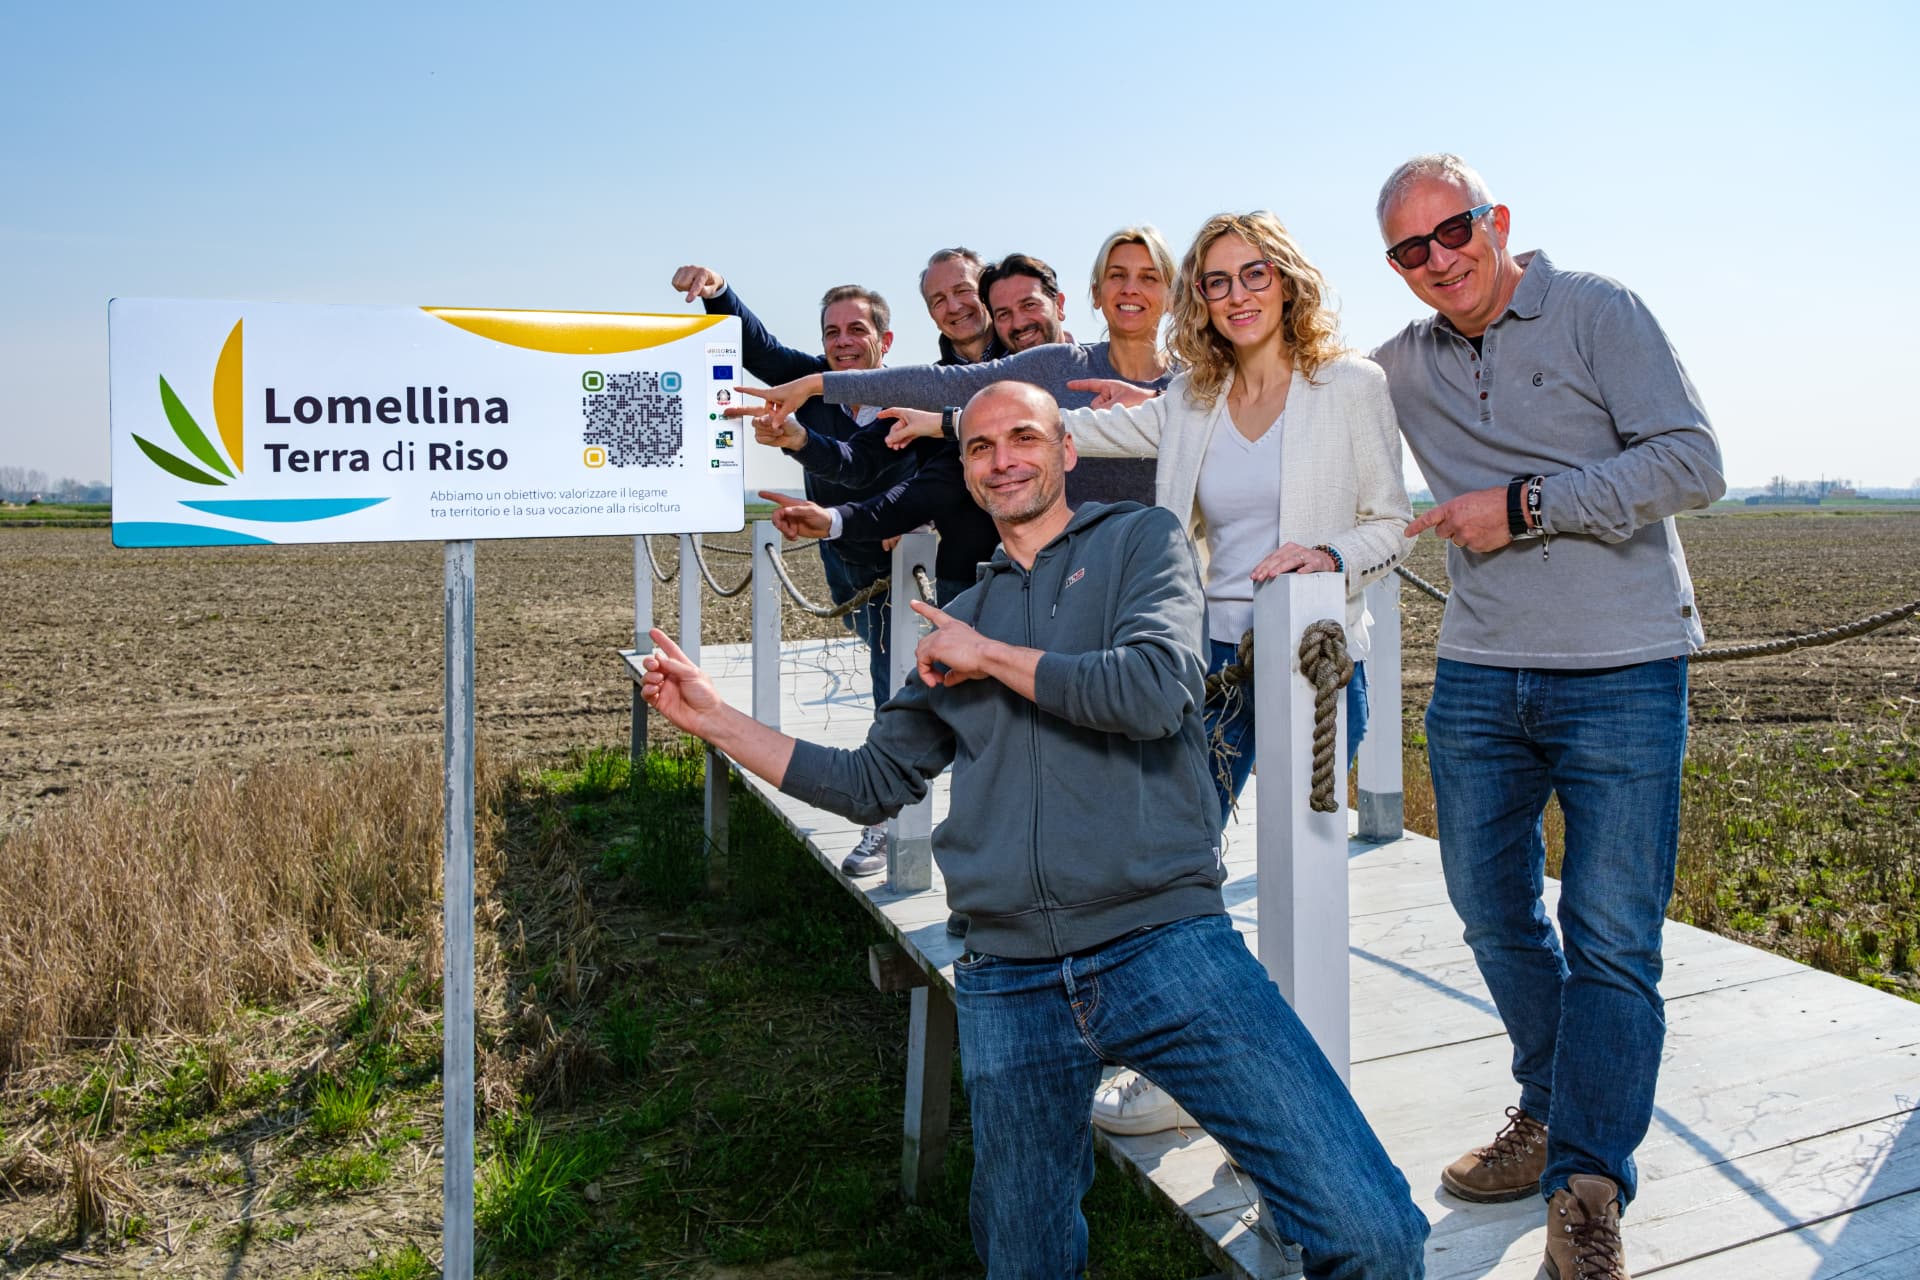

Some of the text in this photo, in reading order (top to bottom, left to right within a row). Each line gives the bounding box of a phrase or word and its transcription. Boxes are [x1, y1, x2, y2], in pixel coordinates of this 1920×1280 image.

[265, 385, 509, 424] Lomellina
[264, 440, 509, 473] Terra di Riso
[430, 487, 668, 501] Abbiamo un obiettivo: valorizzare il legame
[431, 502, 681, 517] tra territorio e la sua vocazione alla risicoltura
